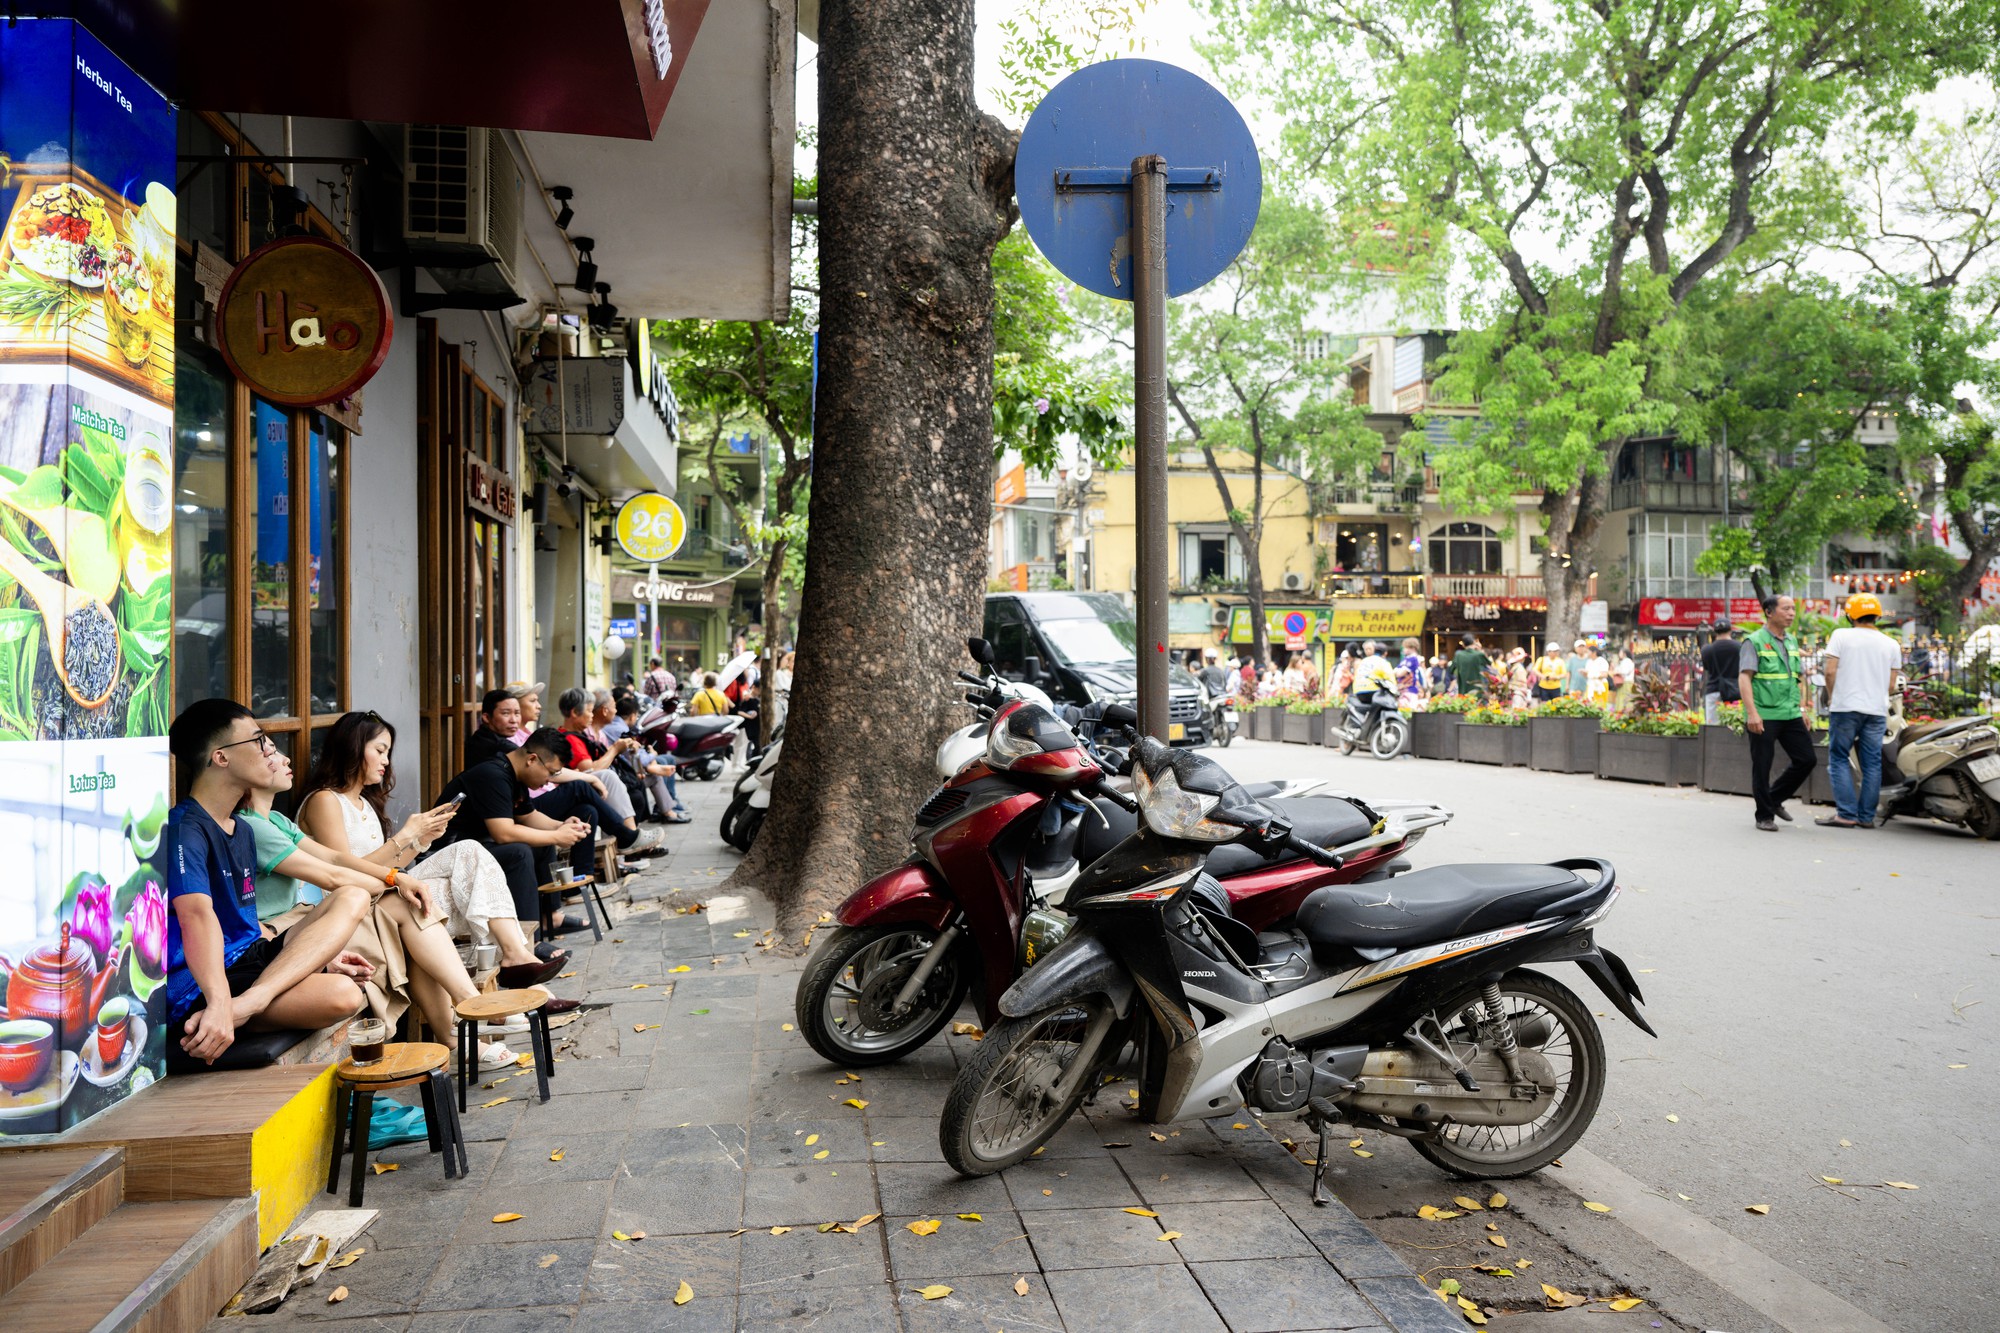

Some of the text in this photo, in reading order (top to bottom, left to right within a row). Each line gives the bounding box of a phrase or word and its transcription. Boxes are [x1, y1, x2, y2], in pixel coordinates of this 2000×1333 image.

[77, 55, 132, 113] Herbal Tea
[255, 290, 361, 355] Hào
[72, 404, 126, 440] Matcha Tea
[631, 509, 672, 539] 26
[69, 771, 115, 793] Lotus Tea
[1183, 970, 1217, 978] HONDA
